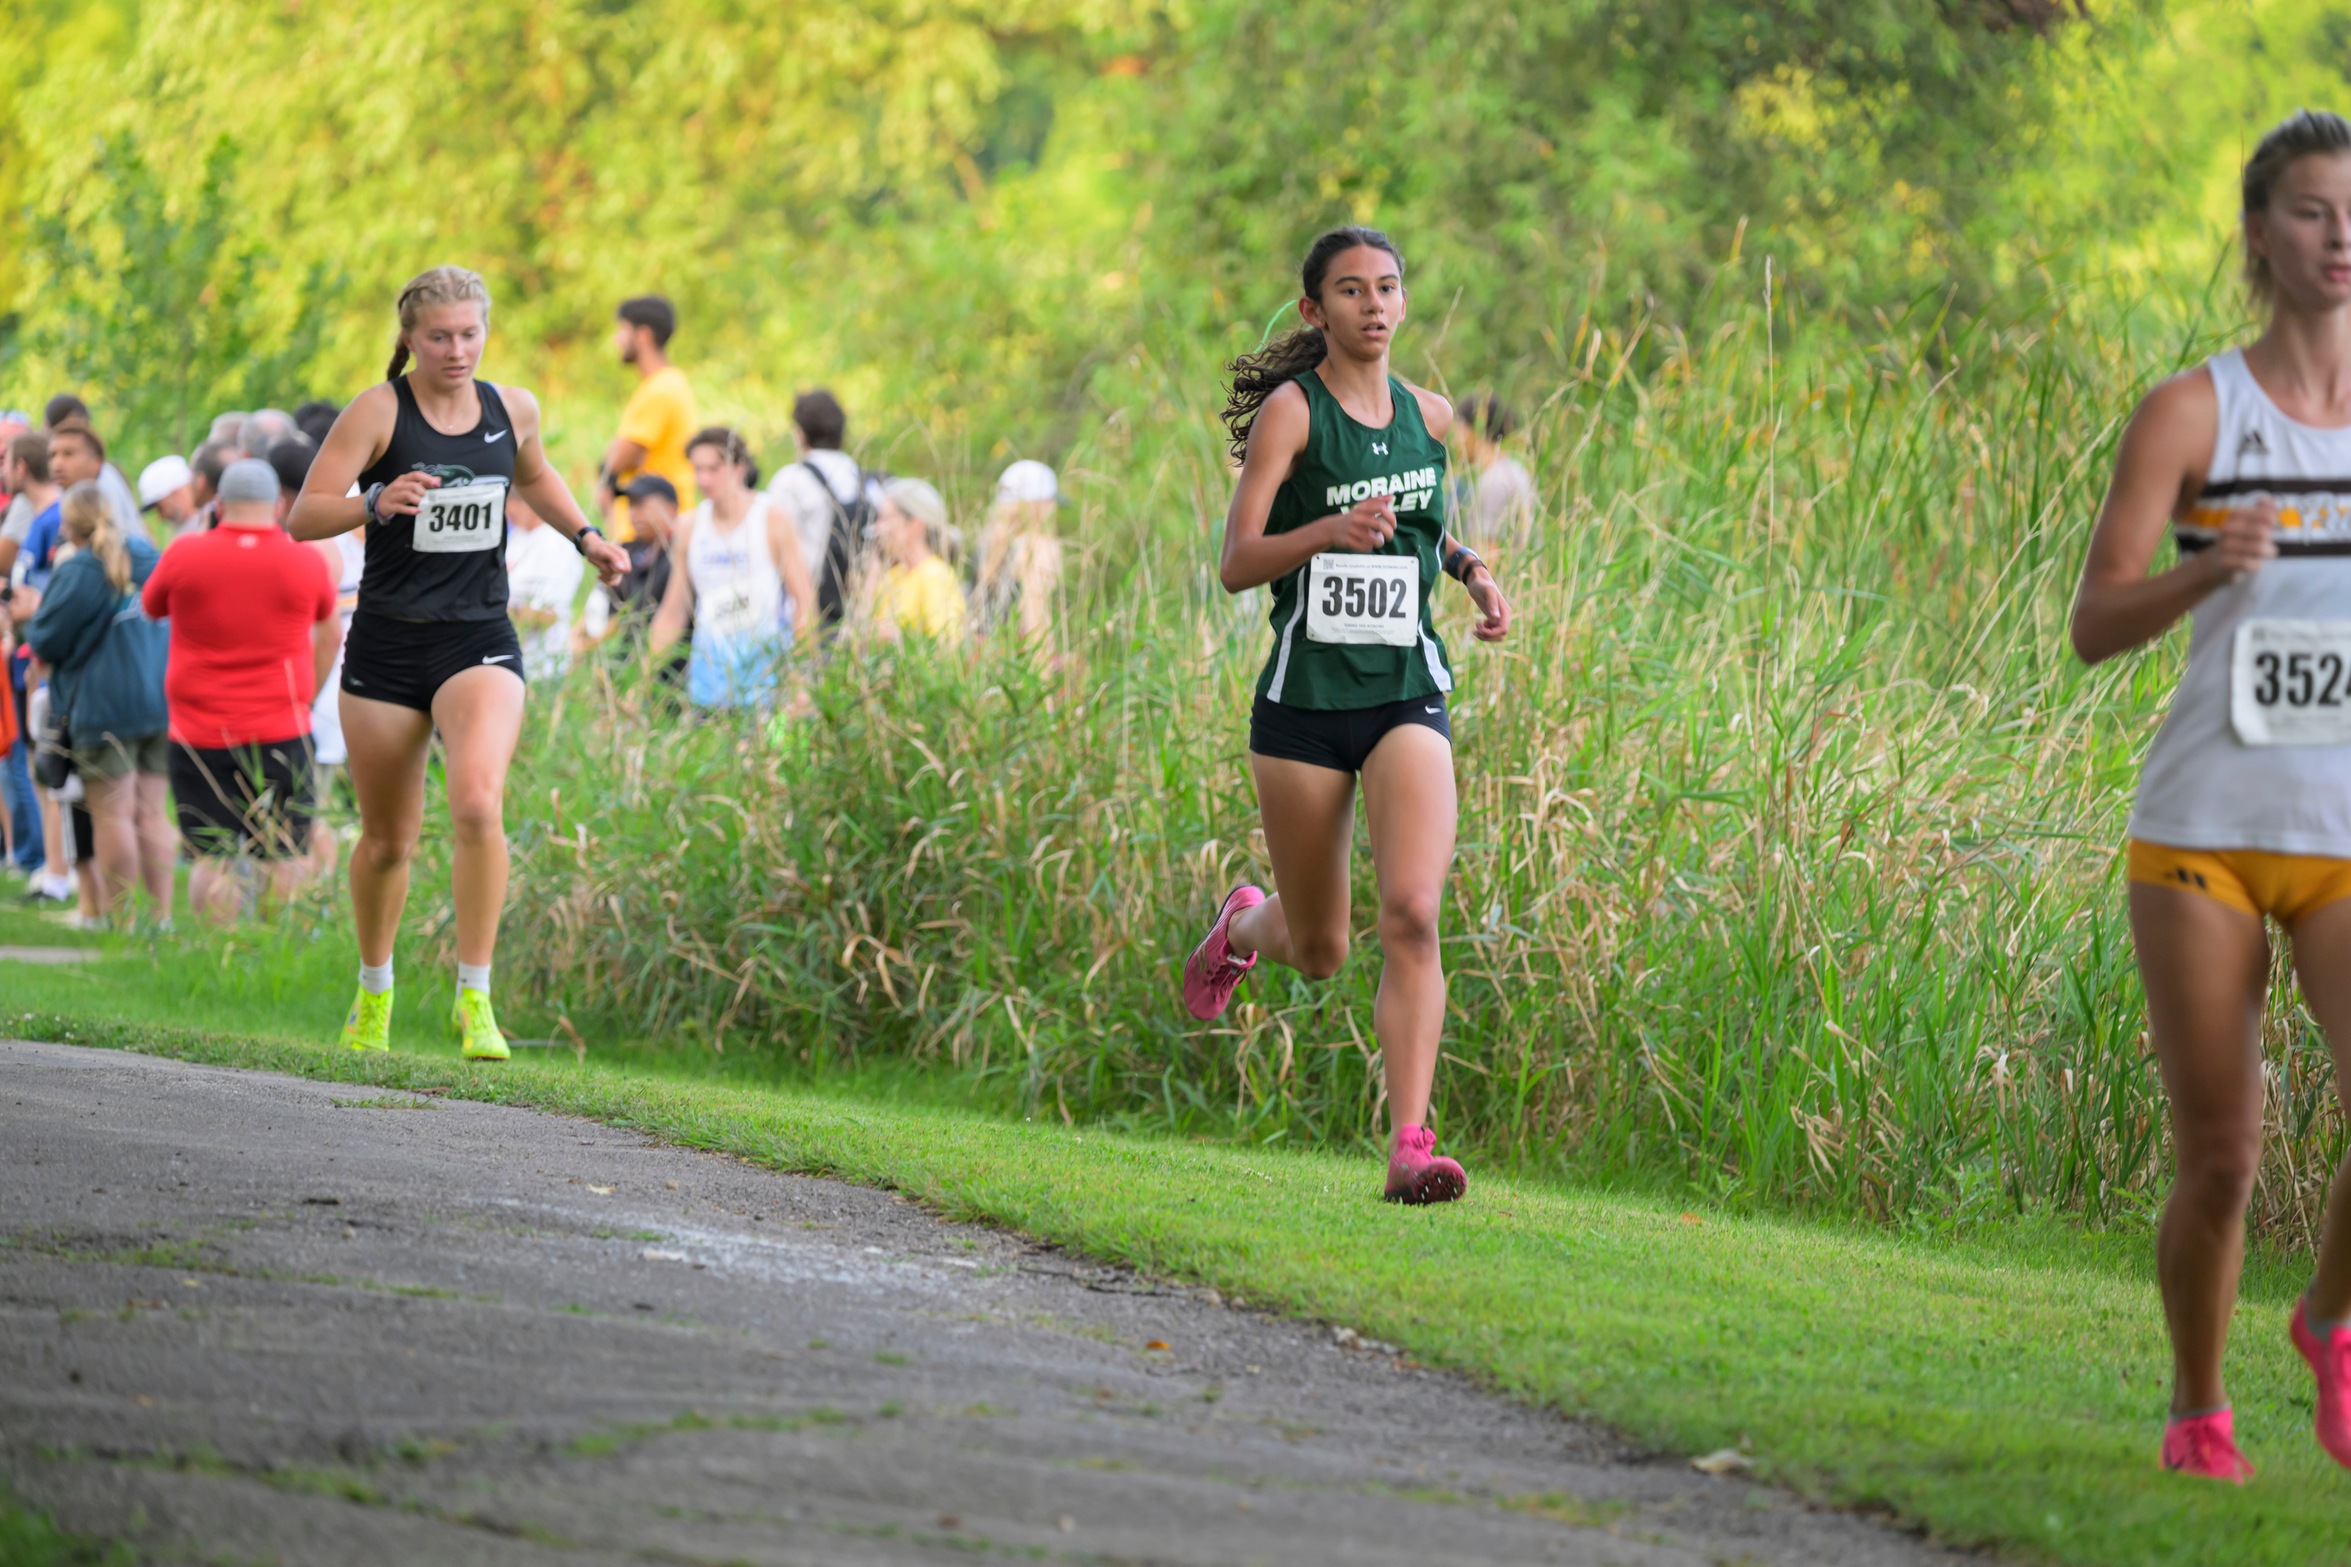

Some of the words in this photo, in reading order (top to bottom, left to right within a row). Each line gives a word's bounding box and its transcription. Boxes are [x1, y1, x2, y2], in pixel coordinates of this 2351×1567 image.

[1326, 466, 1437, 506] MORAINE
[1340, 488, 1434, 515] LEY
[429, 502, 493, 533] 3401
[1321, 575, 1407, 619] 3502
[2254, 650, 2351, 708] 352
